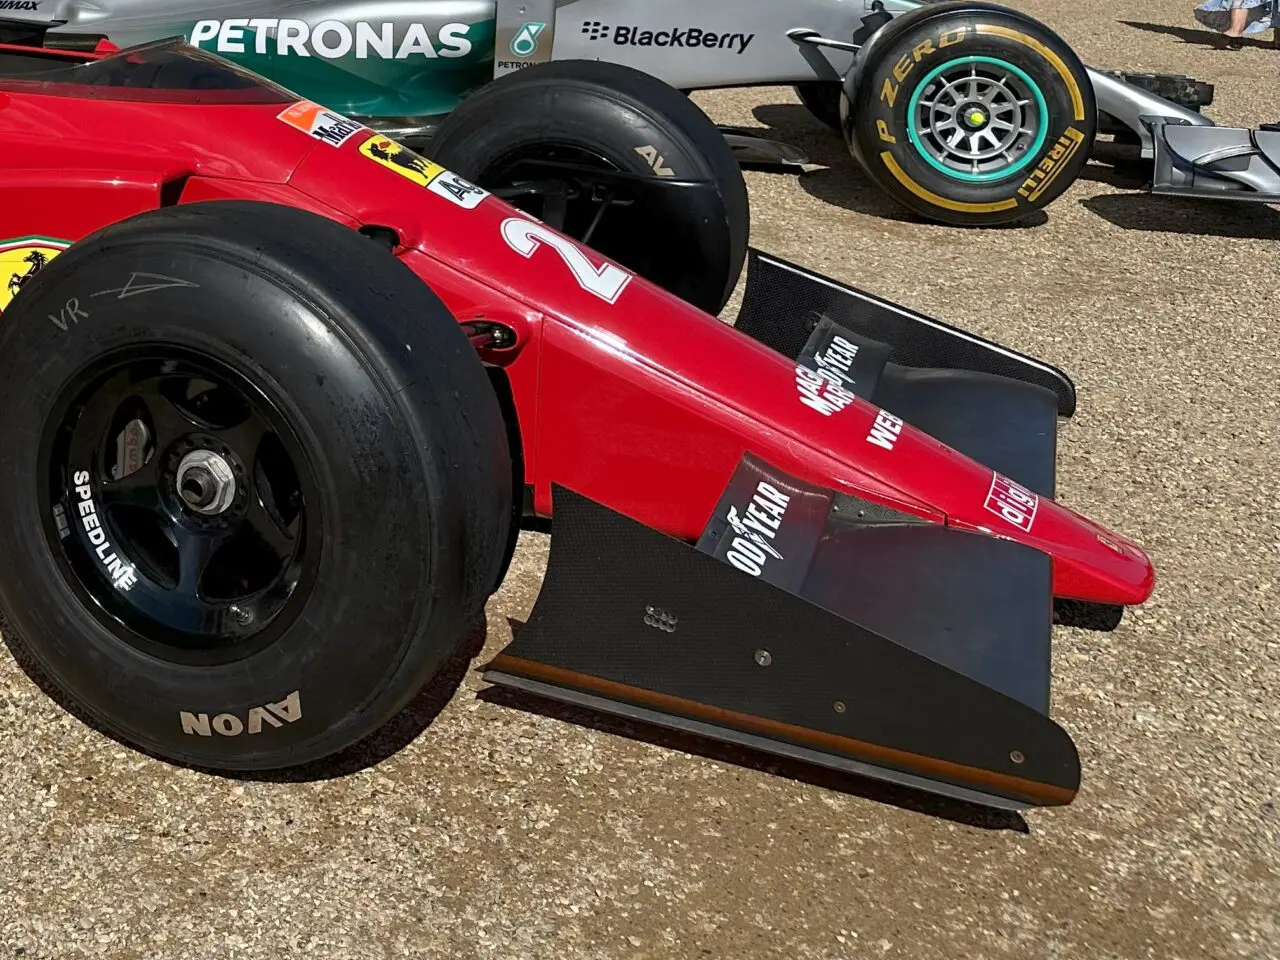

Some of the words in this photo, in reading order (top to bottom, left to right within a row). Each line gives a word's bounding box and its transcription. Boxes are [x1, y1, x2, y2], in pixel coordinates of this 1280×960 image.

[190, 17, 472, 60] PETRONAS
[613, 26, 755, 55] BlackBerry
[880, 25, 967, 108] ZERO
[48, 297, 89, 331] VR
[73, 470, 138, 591] SPEEDLINE
[180, 689, 302, 737] AVON
